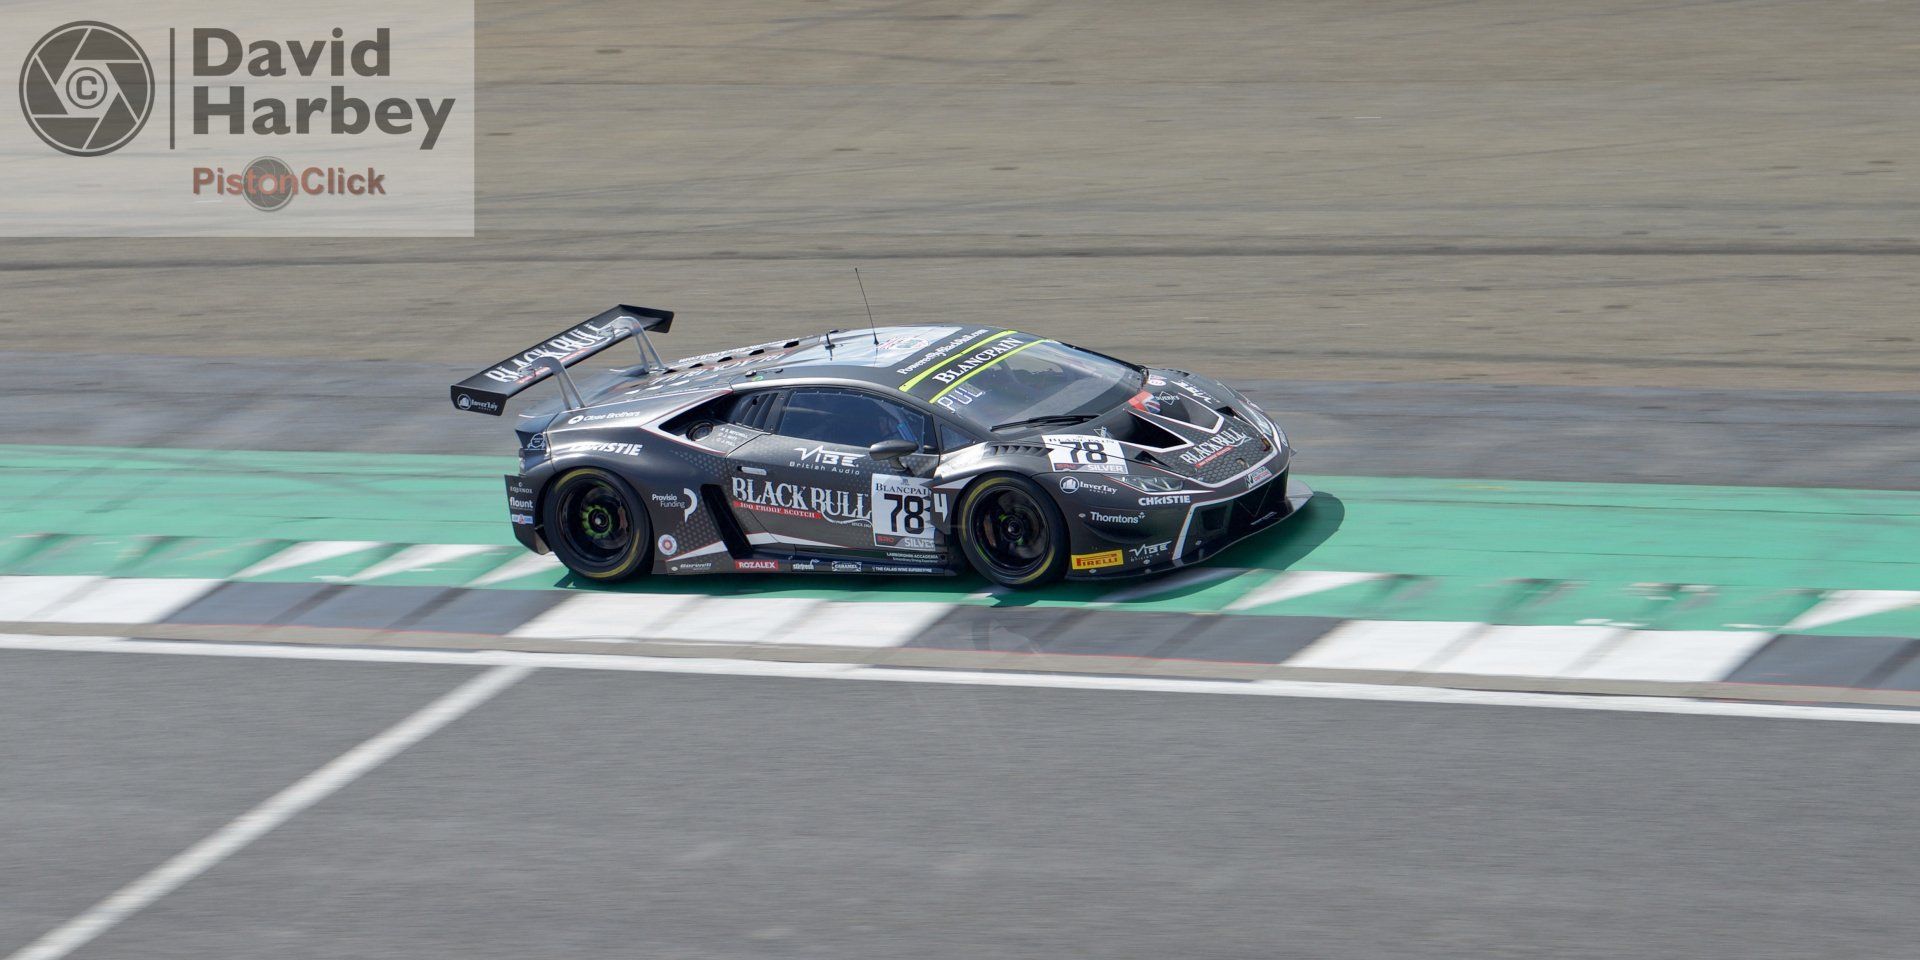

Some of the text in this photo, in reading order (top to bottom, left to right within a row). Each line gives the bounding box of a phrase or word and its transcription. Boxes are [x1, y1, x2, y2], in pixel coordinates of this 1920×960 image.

[932, 337, 1024, 384] BLANCPAIN
[607, 411, 640, 420] Brothers
[571, 441, 643, 456] RISTIE
[1060, 441, 1108, 464] 78
[794, 445, 866, 468] VIBE
[789, 461, 860, 476] British Audio
[1087, 464, 1123, 472] SILVER
[1080, 480, 1118, 494] InverTay
[652, 493, 677, 502] Provisio
[660, 500, 685, 509] Funding
[732, 477, 872, 520] BLACK BULL
[1138, 495, 1191, 506] CHRISTIE
[784, 508, 815, 518] SCOTCH
[884, 493, 925, 535] 78
[1090, 511, 1139, 524] Thorntons
[738, 561, 776, 569] ROZALEX
[1076, 553, 1118, 567] PIRELLI
